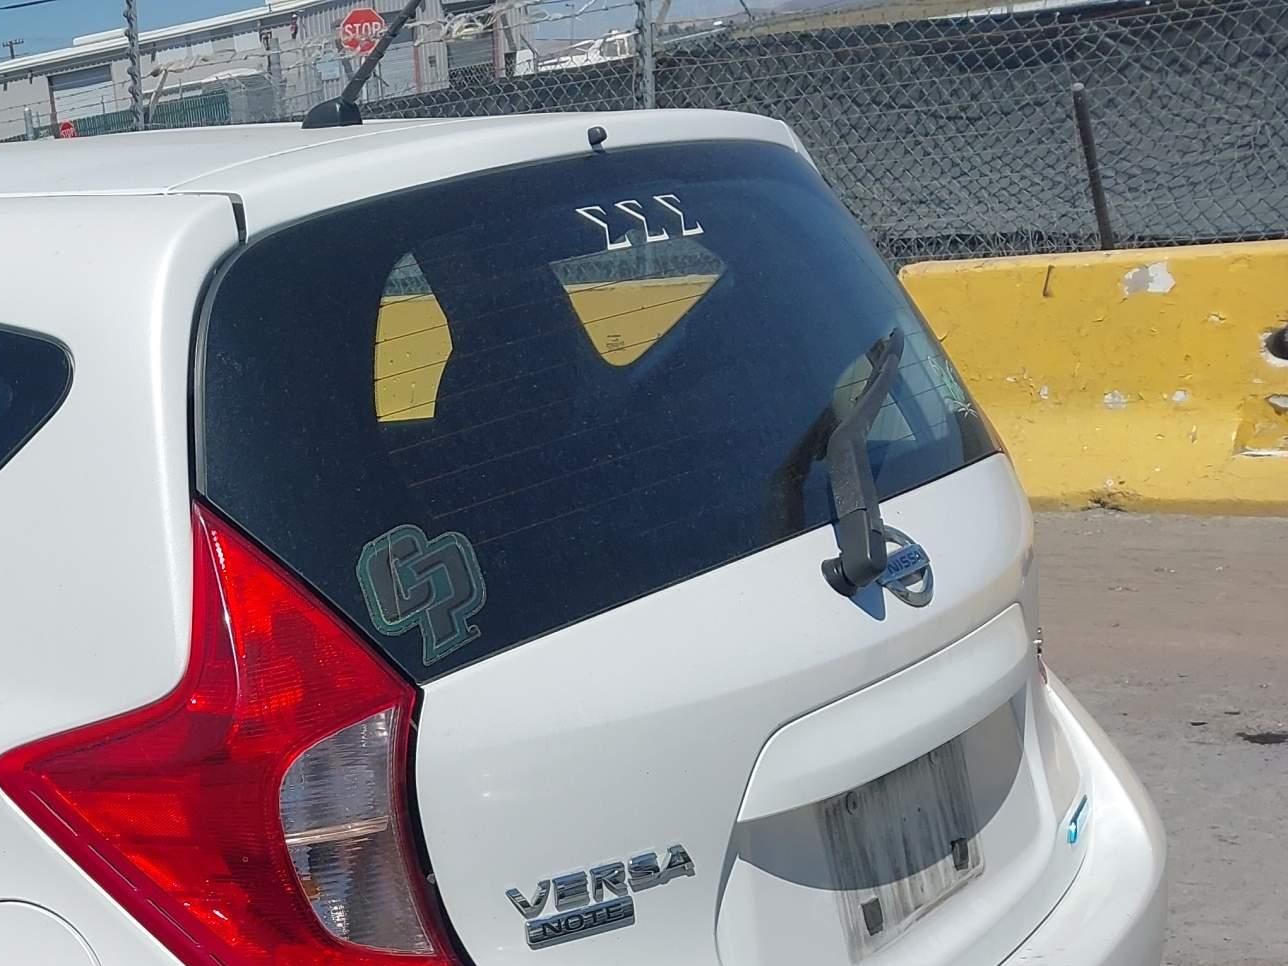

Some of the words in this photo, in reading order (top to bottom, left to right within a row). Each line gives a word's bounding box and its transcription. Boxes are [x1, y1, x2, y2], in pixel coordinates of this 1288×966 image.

[344, 21, 382, 38] STOP
[887, 550, 925, 575] NISSA
[505, 844, 696, 919] VERSA
[538, 899, 628, 940] NOTE
